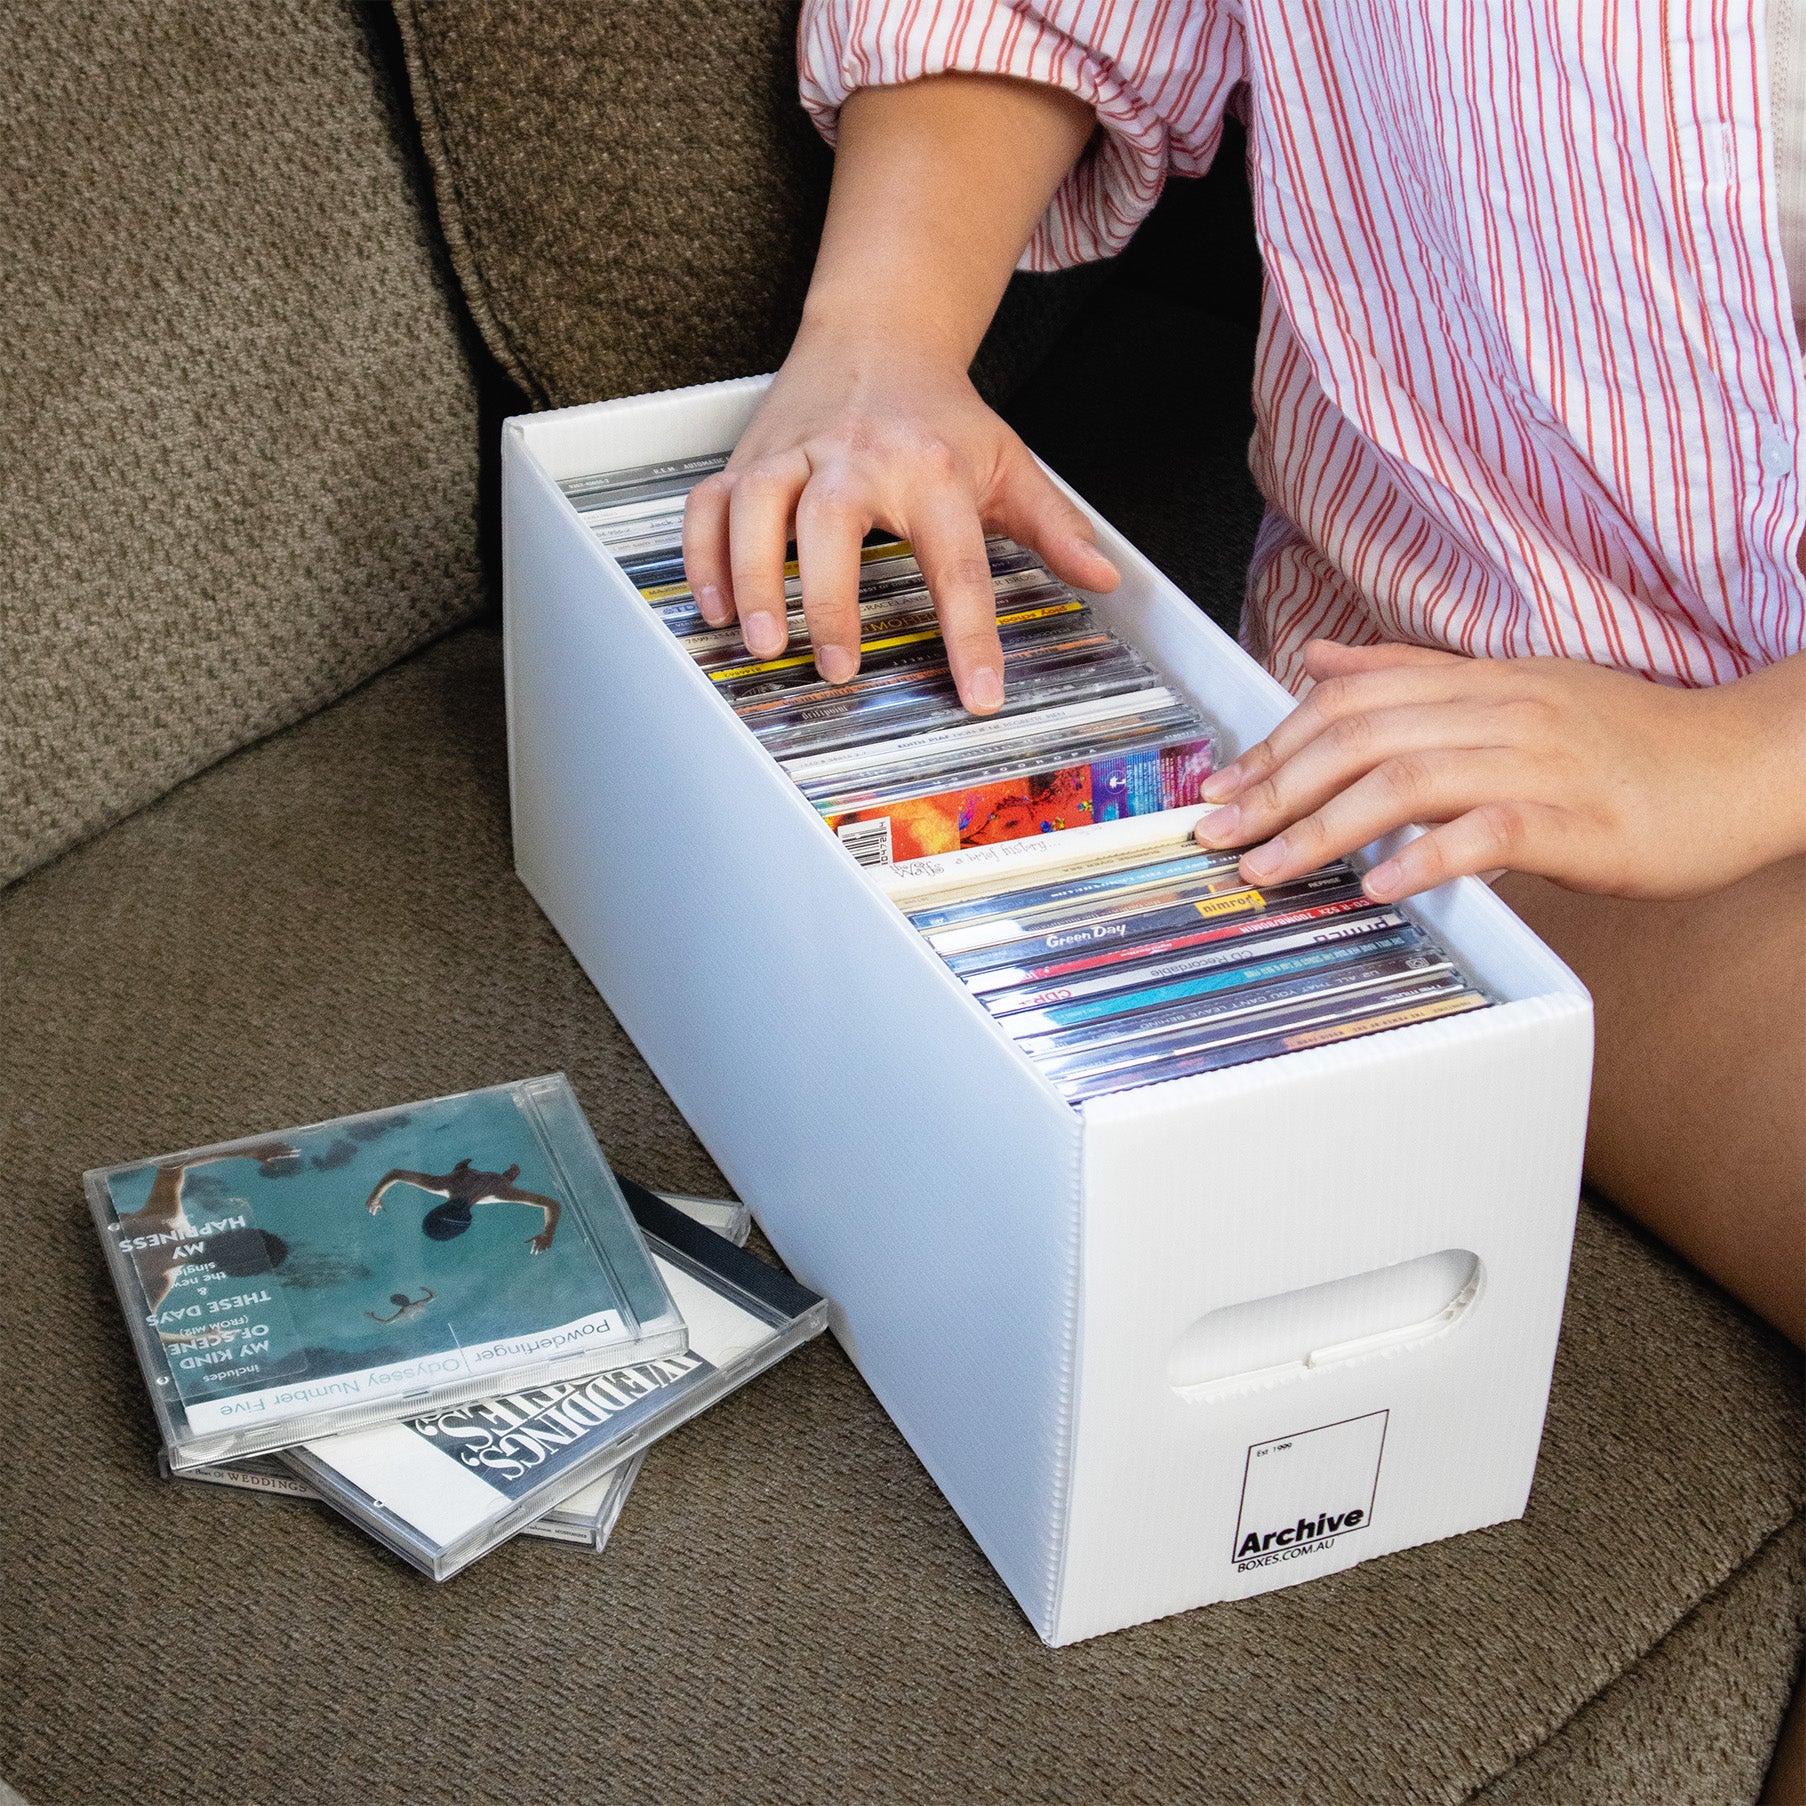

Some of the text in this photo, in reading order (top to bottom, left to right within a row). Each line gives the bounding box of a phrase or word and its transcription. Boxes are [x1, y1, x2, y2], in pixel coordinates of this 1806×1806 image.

[684, 456, 725, 471] AUTOMATIC
[1318, 905, 1338, 915] 52x
[1339, 898, 1370, 911] CD-R
[1046, 931, 1092, 948] Green
[1092, 924, 1127, 938] Day
[1232, 949, 1253, 961] CD
[1150, 956, 1228, 977] Recordable
[1301, 981, 1330, 992] THAT
[1335, 974, 1356, 984] ALL
[1270, 988, 1298, 999] YOU
[119, 1216, 246, 1252] HAPPINESS
[172, 1241, 204, 1259] MY
[204, 1272, 226, 1282] the
[145, 1290, 272, 1326] THESE DAYS
[209, 1315, 249, 1329] (FROM
[168, 1324, 269, 1355] OF SCENE
[179, 1340, 269, 1370] MY KIND
[203, 1364, 260, 1382] includes
[220, 1320, 611, 1416] Powderfinger Odyssey Number Five
[227, 1472, 307, 1493] WEDDINGS
[1237, 1509, 1364, 1557] Archive
[1237, 1538, 1335, 1573] BOXES.COM.AU
